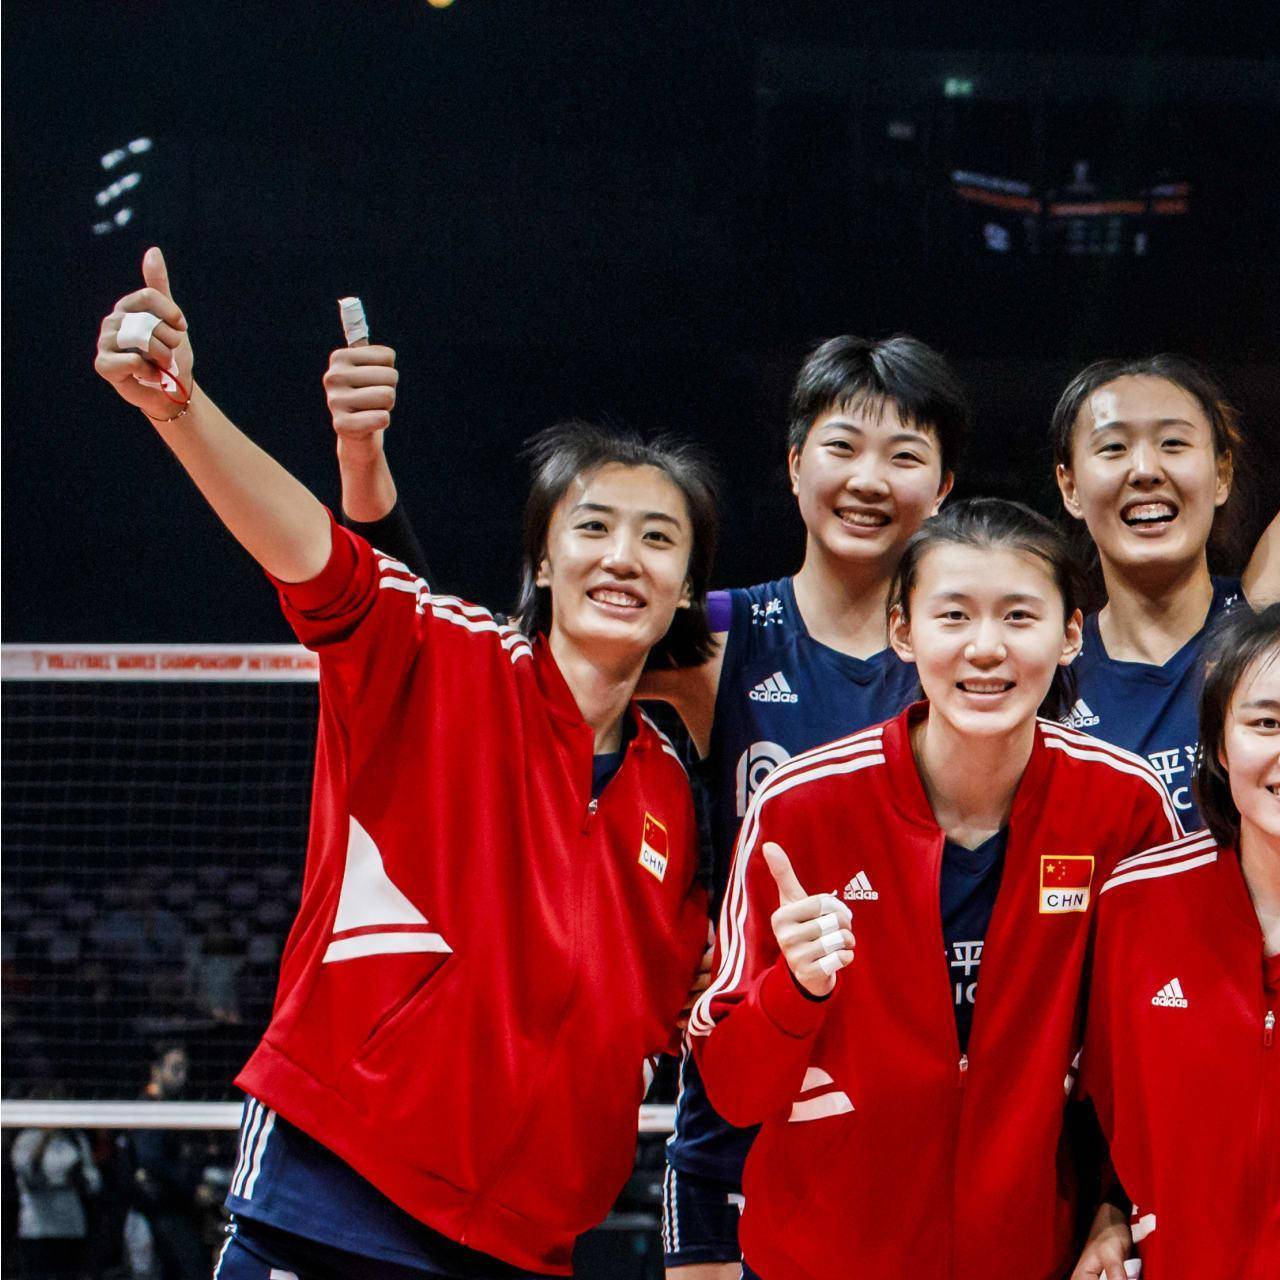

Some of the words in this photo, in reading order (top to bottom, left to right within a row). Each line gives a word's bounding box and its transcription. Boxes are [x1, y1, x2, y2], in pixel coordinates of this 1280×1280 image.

[749, 689, 798, 704] adidas
[642, 849, 665, 873] CHN
[1047, 893, 1084, 908] CHN
[1151, 996, 1189, 1009] adidas
